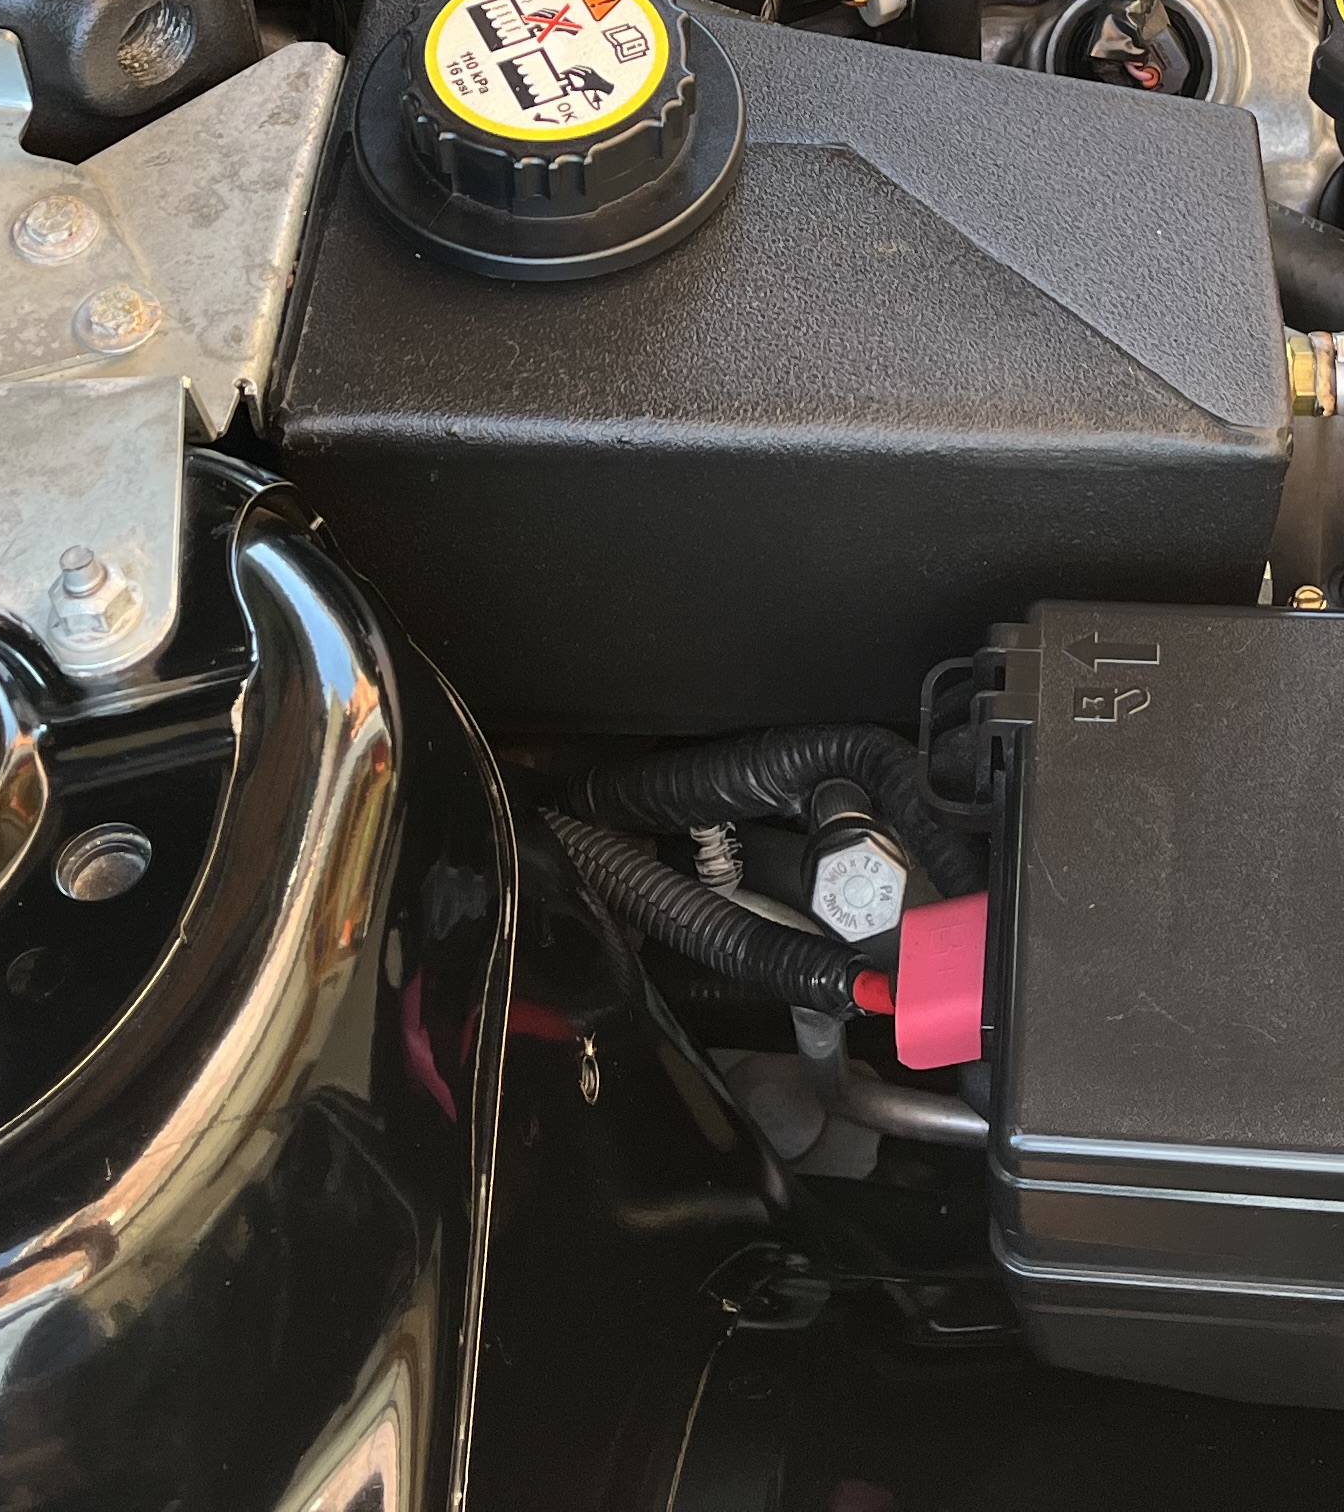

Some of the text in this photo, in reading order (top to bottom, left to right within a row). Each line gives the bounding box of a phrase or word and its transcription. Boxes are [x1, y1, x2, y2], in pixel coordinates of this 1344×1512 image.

[446, 61, 473, 96] 16 psi
[460, 50, 490, 95] 110 kPa
[556, 102, 579, 123] OK
[1300, 215, 1324, 232] IN
[823, 893, 858, 930] VIKING
